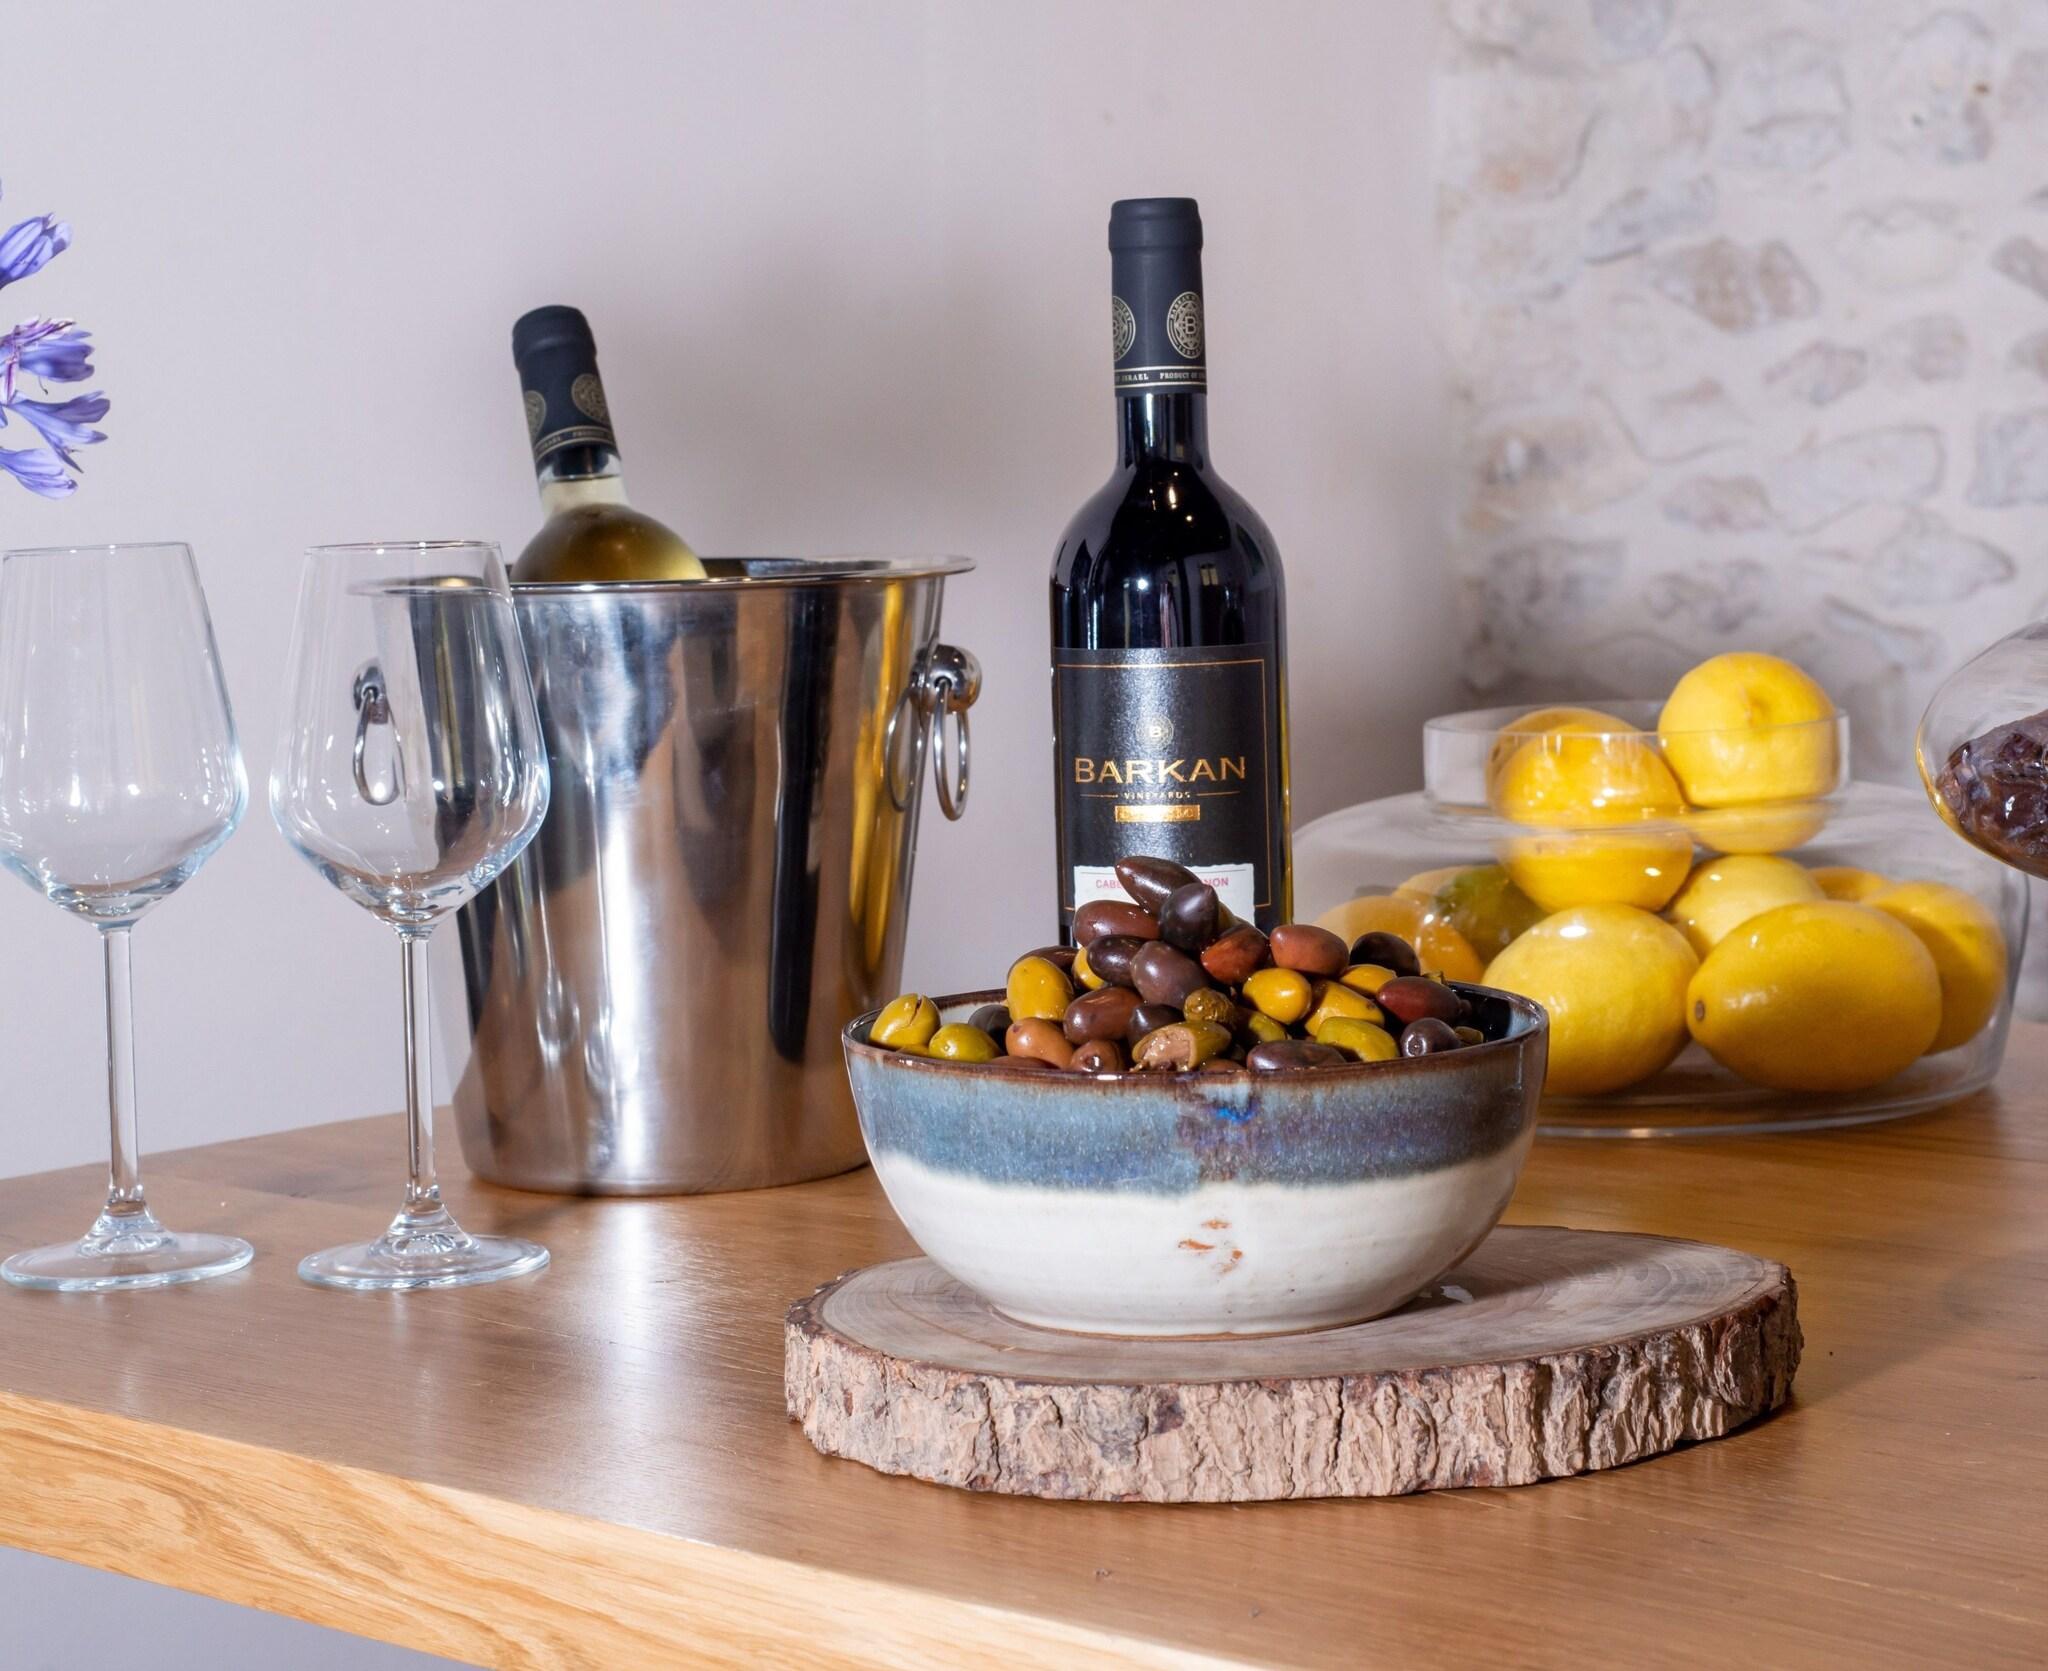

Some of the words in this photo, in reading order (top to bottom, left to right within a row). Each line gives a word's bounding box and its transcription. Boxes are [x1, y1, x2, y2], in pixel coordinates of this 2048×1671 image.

[1185, 316, 1196, 335] B
[1121, 373, 1149, 382] ISRAEL
[1159, 372, 1189, 380] PRODUCT
[1074, 756, 1246, 784] BARKAN
[1124, 791, 1191, 800] VINEYARDS
